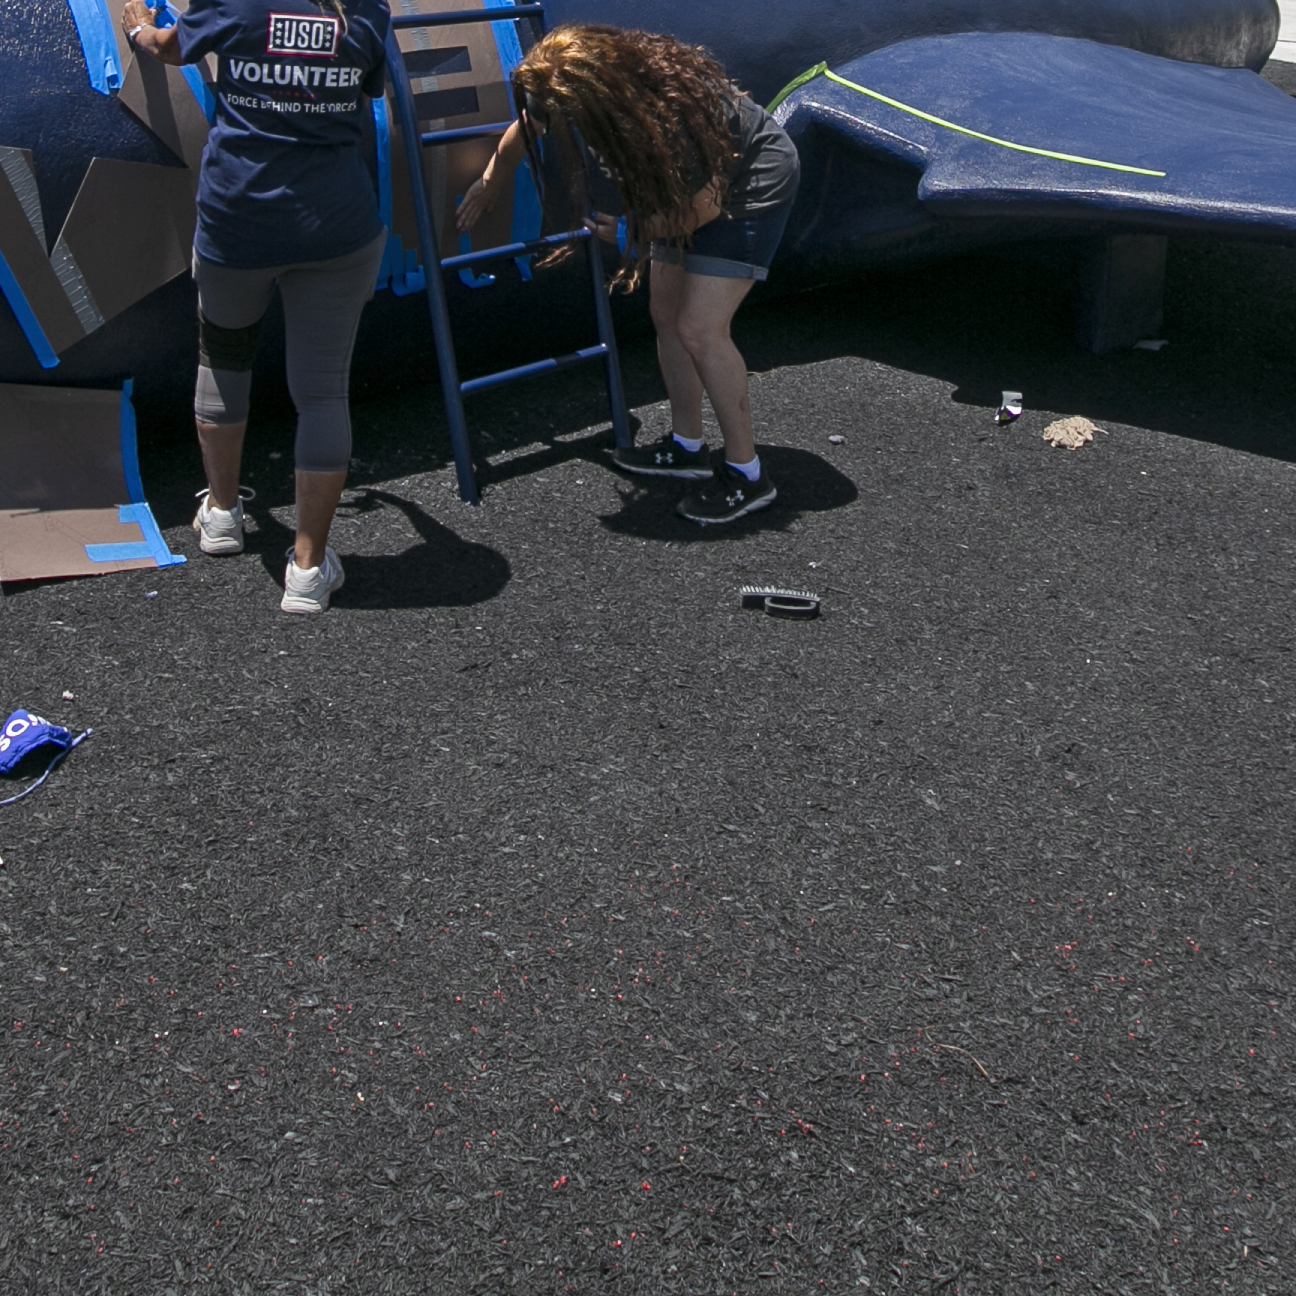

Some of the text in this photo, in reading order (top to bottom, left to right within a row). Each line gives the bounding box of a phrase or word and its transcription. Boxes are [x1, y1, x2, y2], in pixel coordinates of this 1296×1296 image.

[283, 20, 324, 49] USO
[229, 59, 362, 87] VOLUNTEER
[227, 93, 258, 109] FORCE
[261, 99, 302, 113] BEHIND
[304, 103, 326, 113] THE
